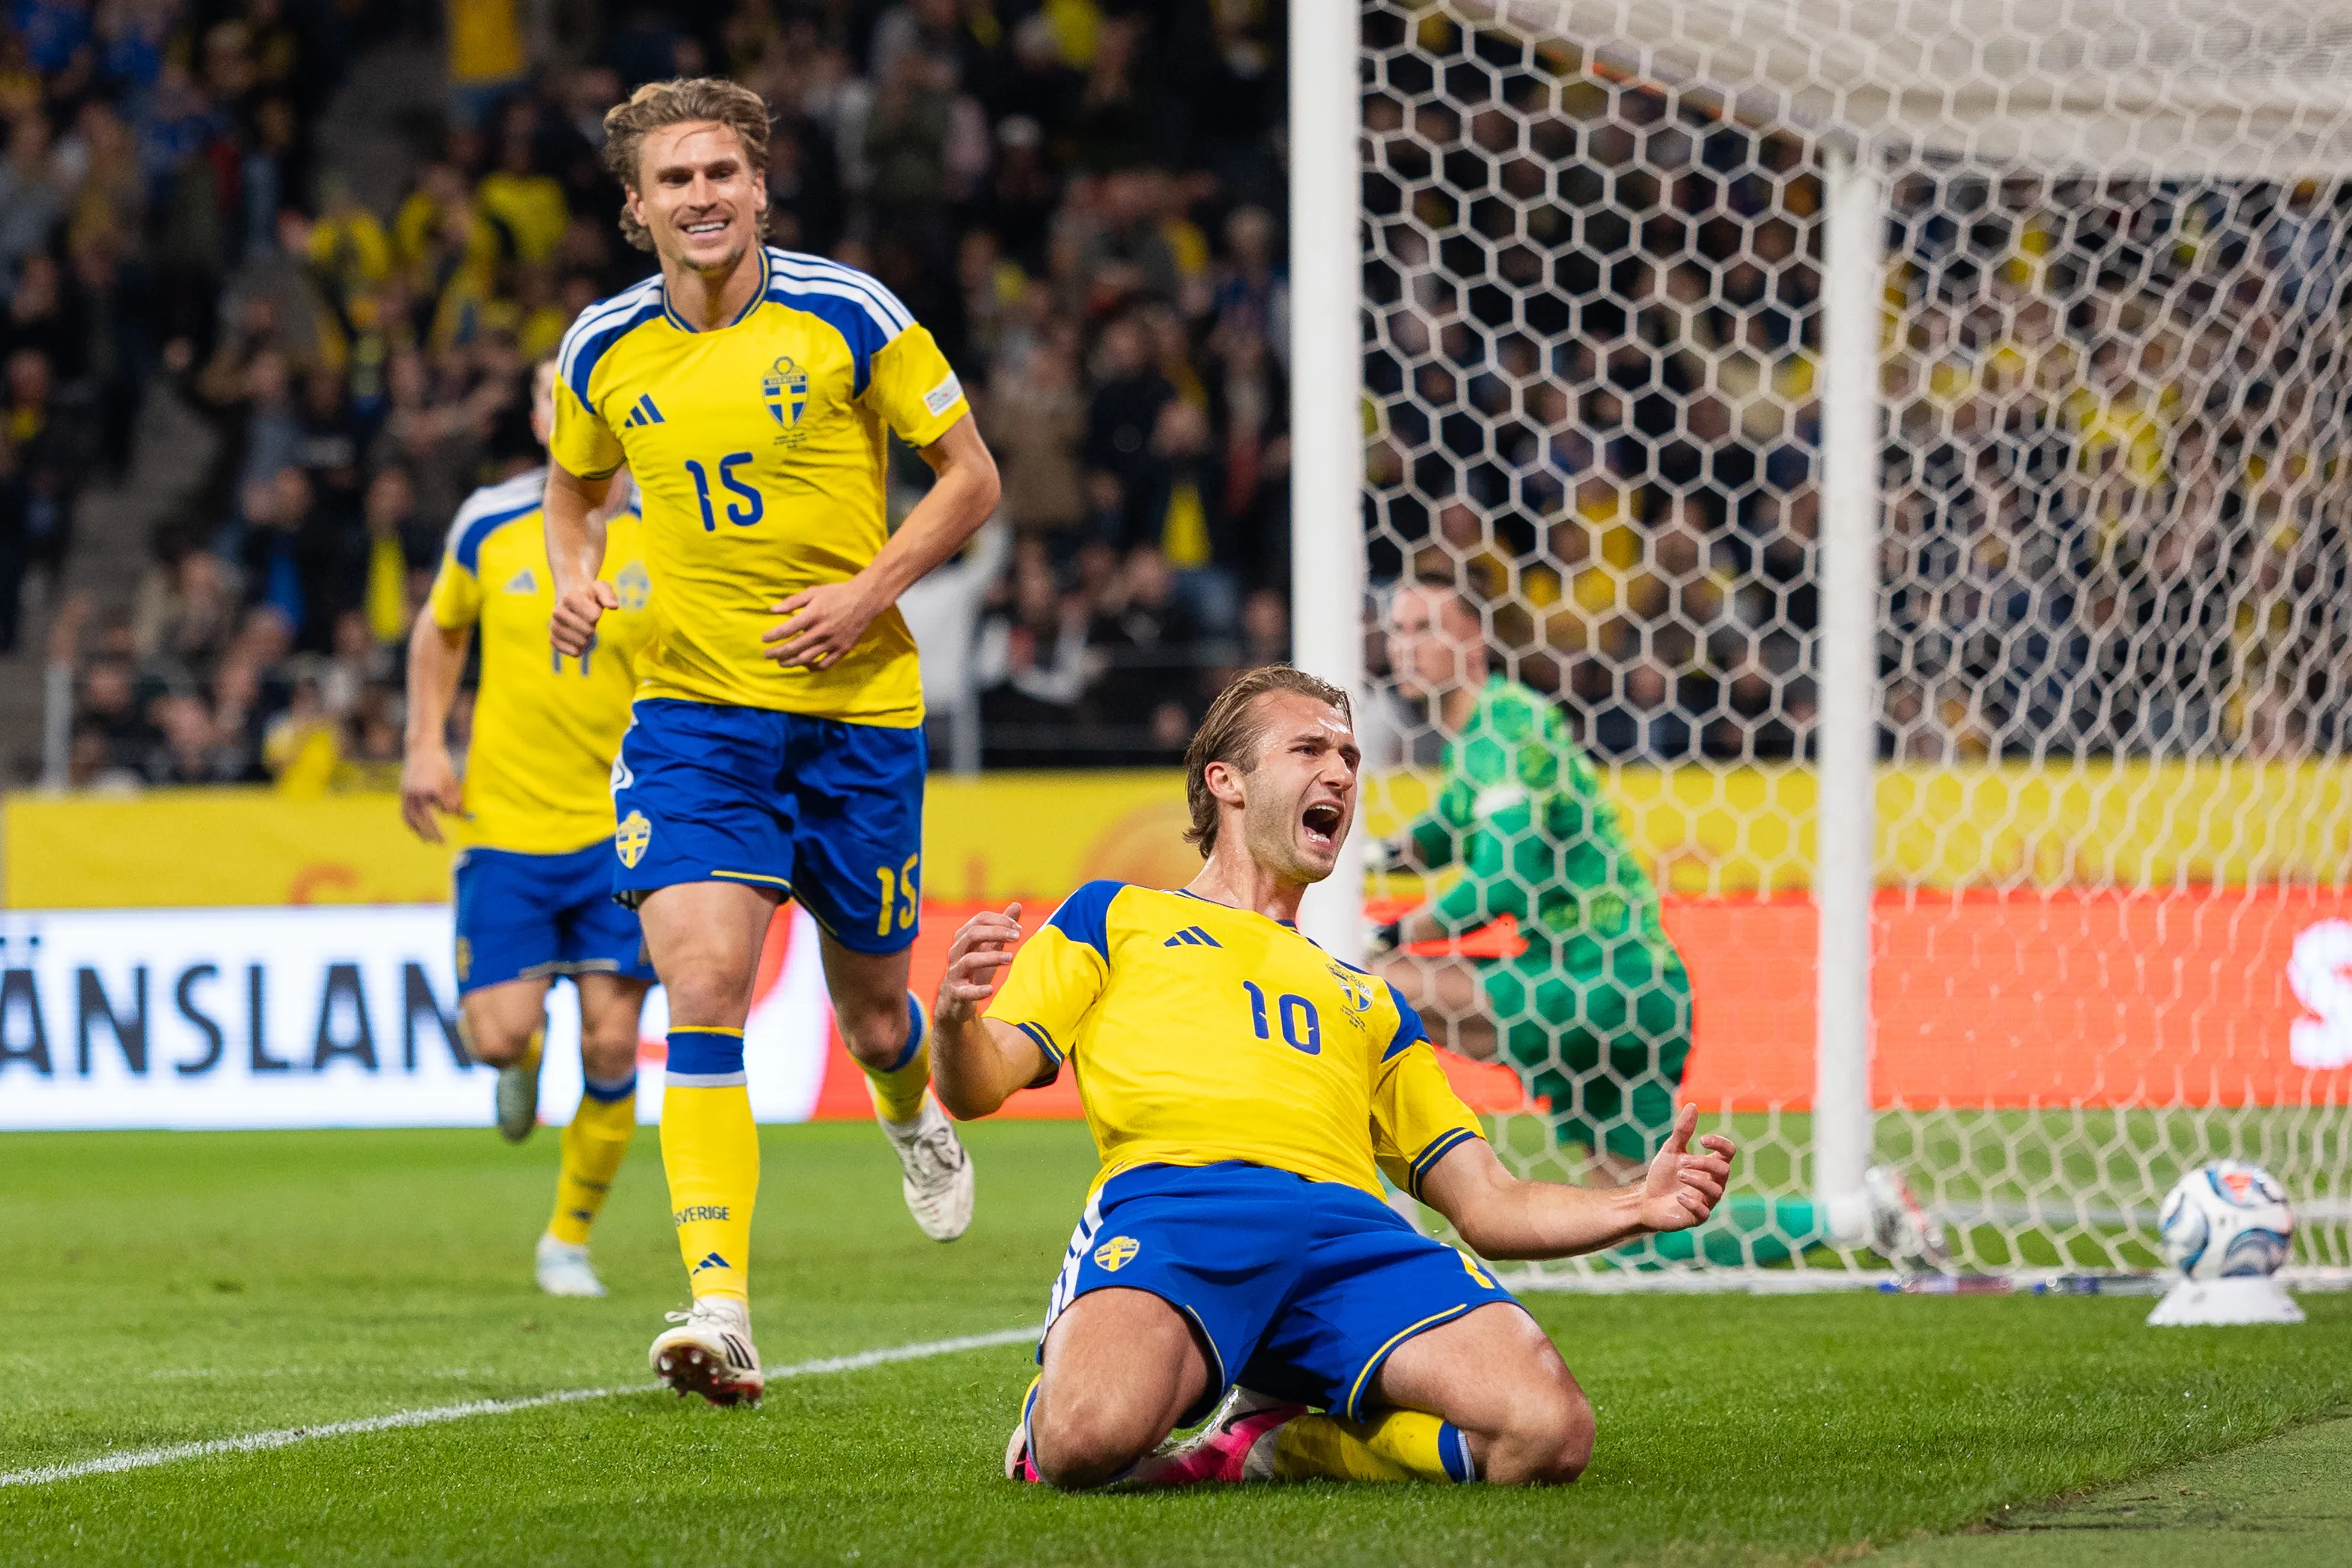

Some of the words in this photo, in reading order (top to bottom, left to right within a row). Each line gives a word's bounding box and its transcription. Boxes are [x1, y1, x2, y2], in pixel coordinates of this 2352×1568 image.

[685, 451, 764, 532] 15
[875, 852, 919, 936] 15
[1243, 980, 1321, 1056] 10
[673, 1204, 731, 1228] SVERIGE
